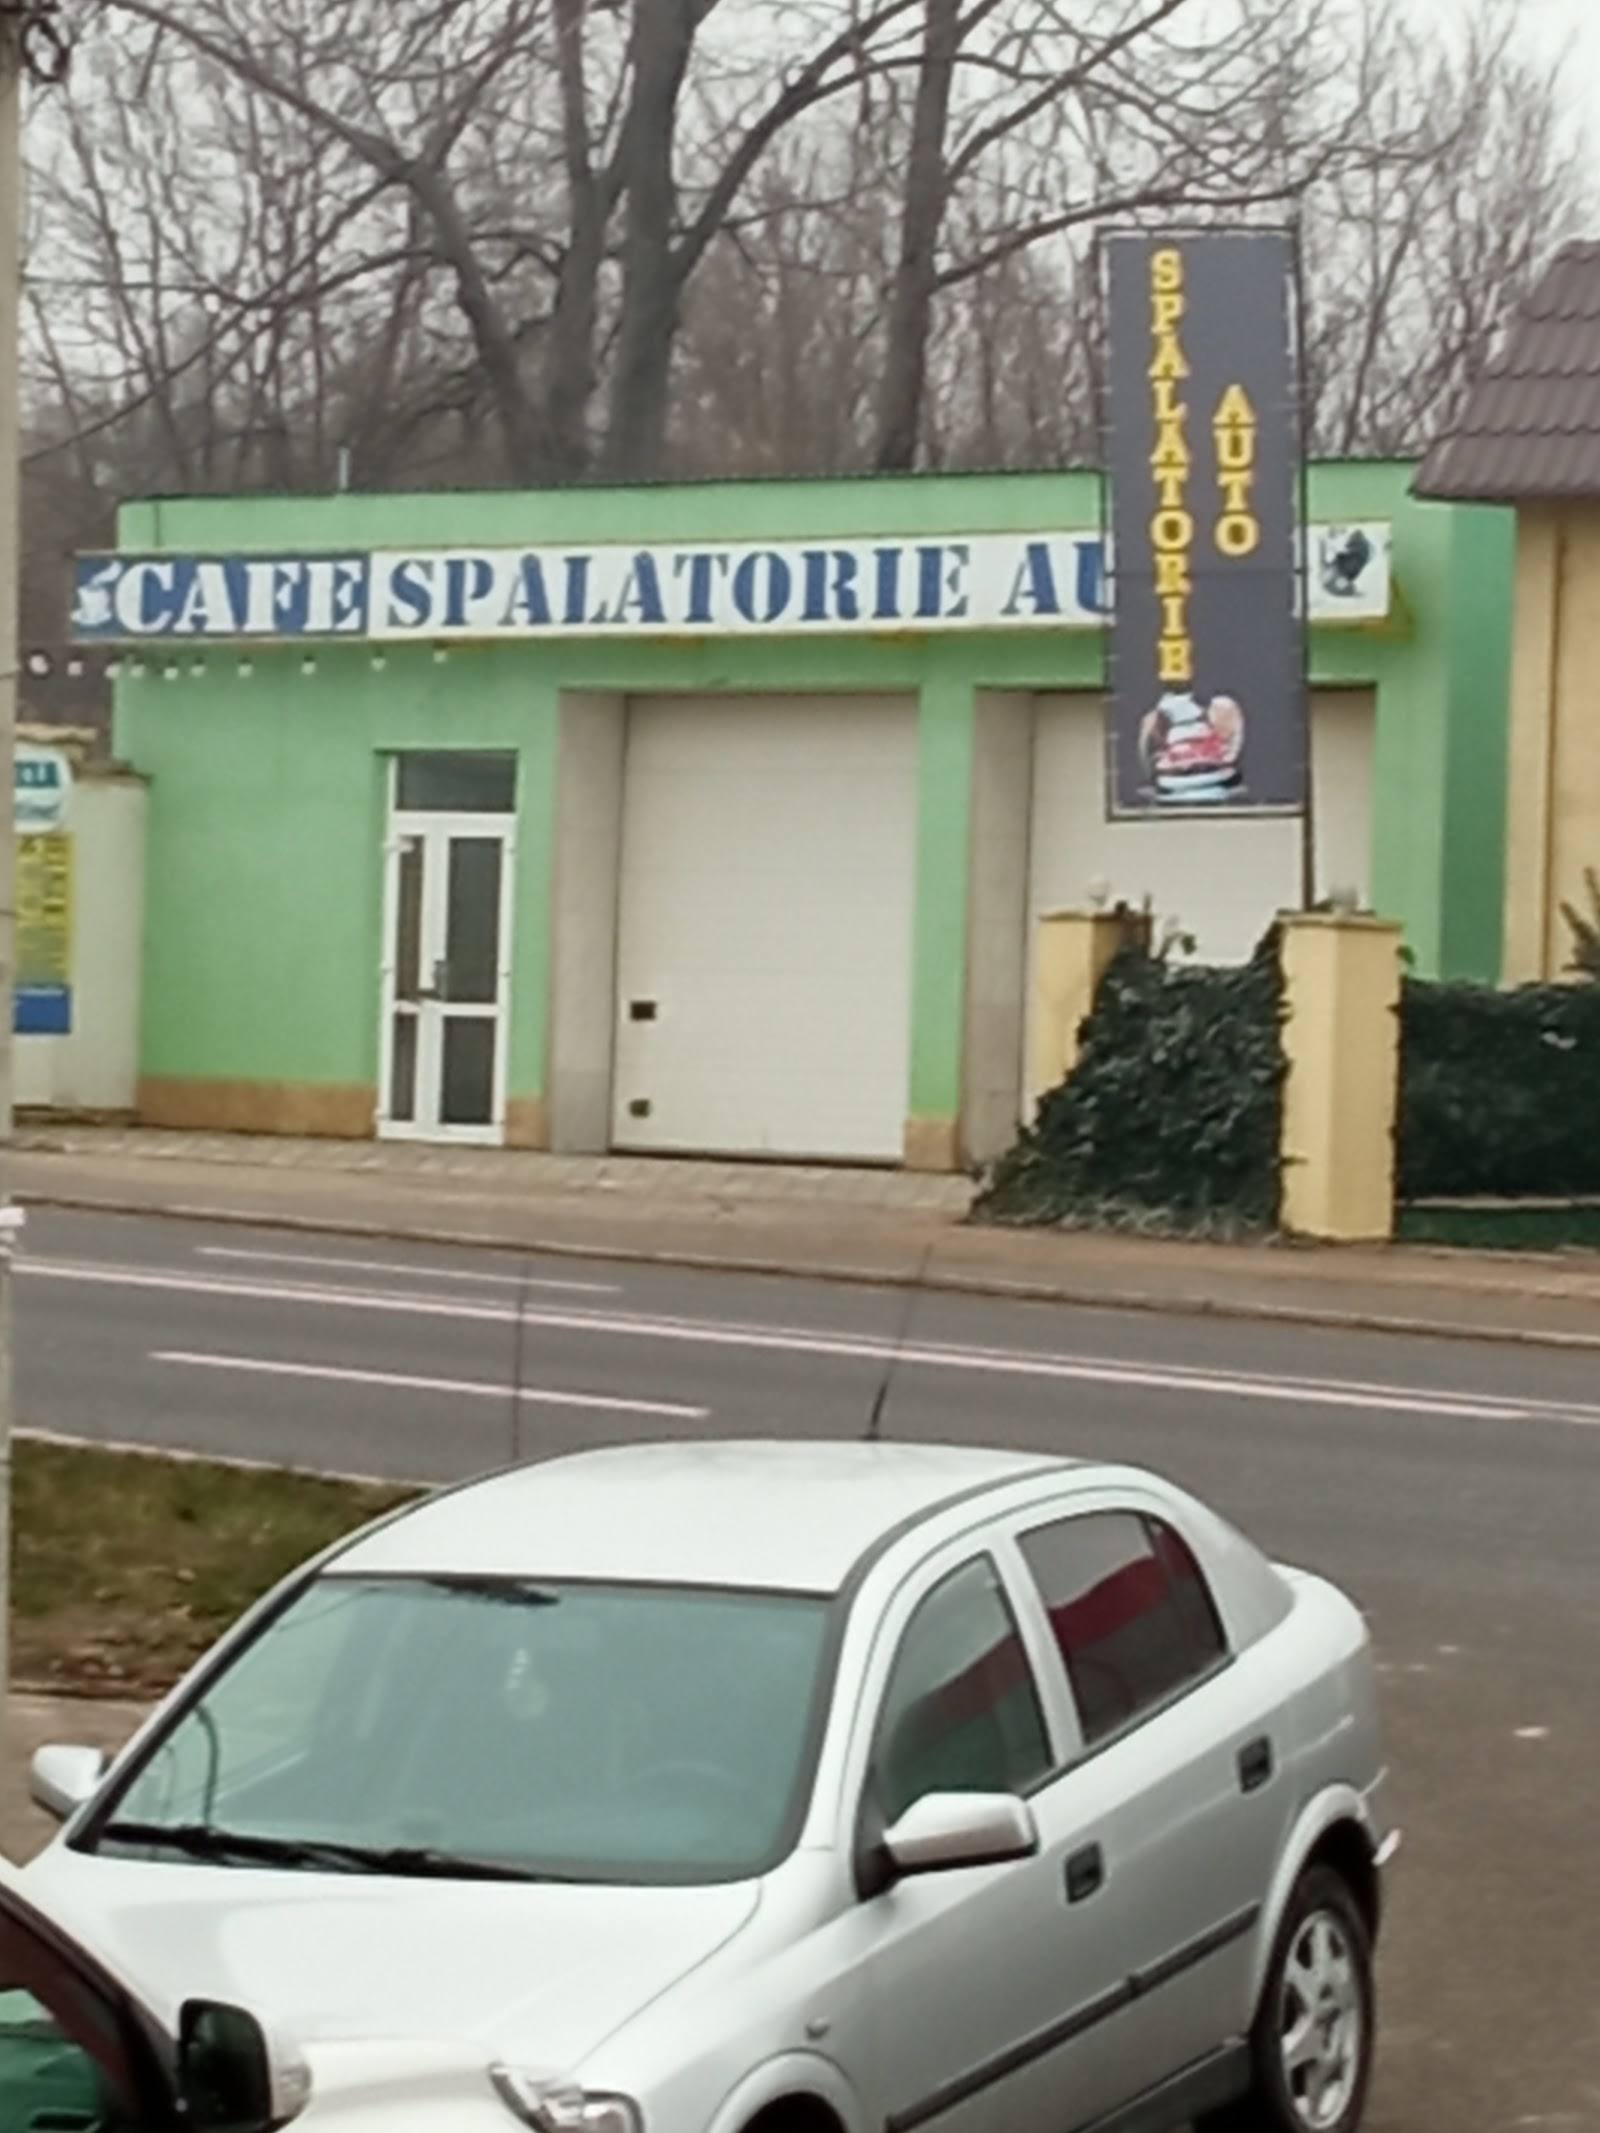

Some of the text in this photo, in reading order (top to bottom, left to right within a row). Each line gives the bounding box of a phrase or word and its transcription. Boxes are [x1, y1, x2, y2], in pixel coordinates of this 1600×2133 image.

[1149, 249, 1194, 682] SPALATORIE
[1212, 384, 1258, 556] AUTO
[116, 561, 363, 634] CAFE
[387, 541, 1114, 628] SPALATORIE AU
